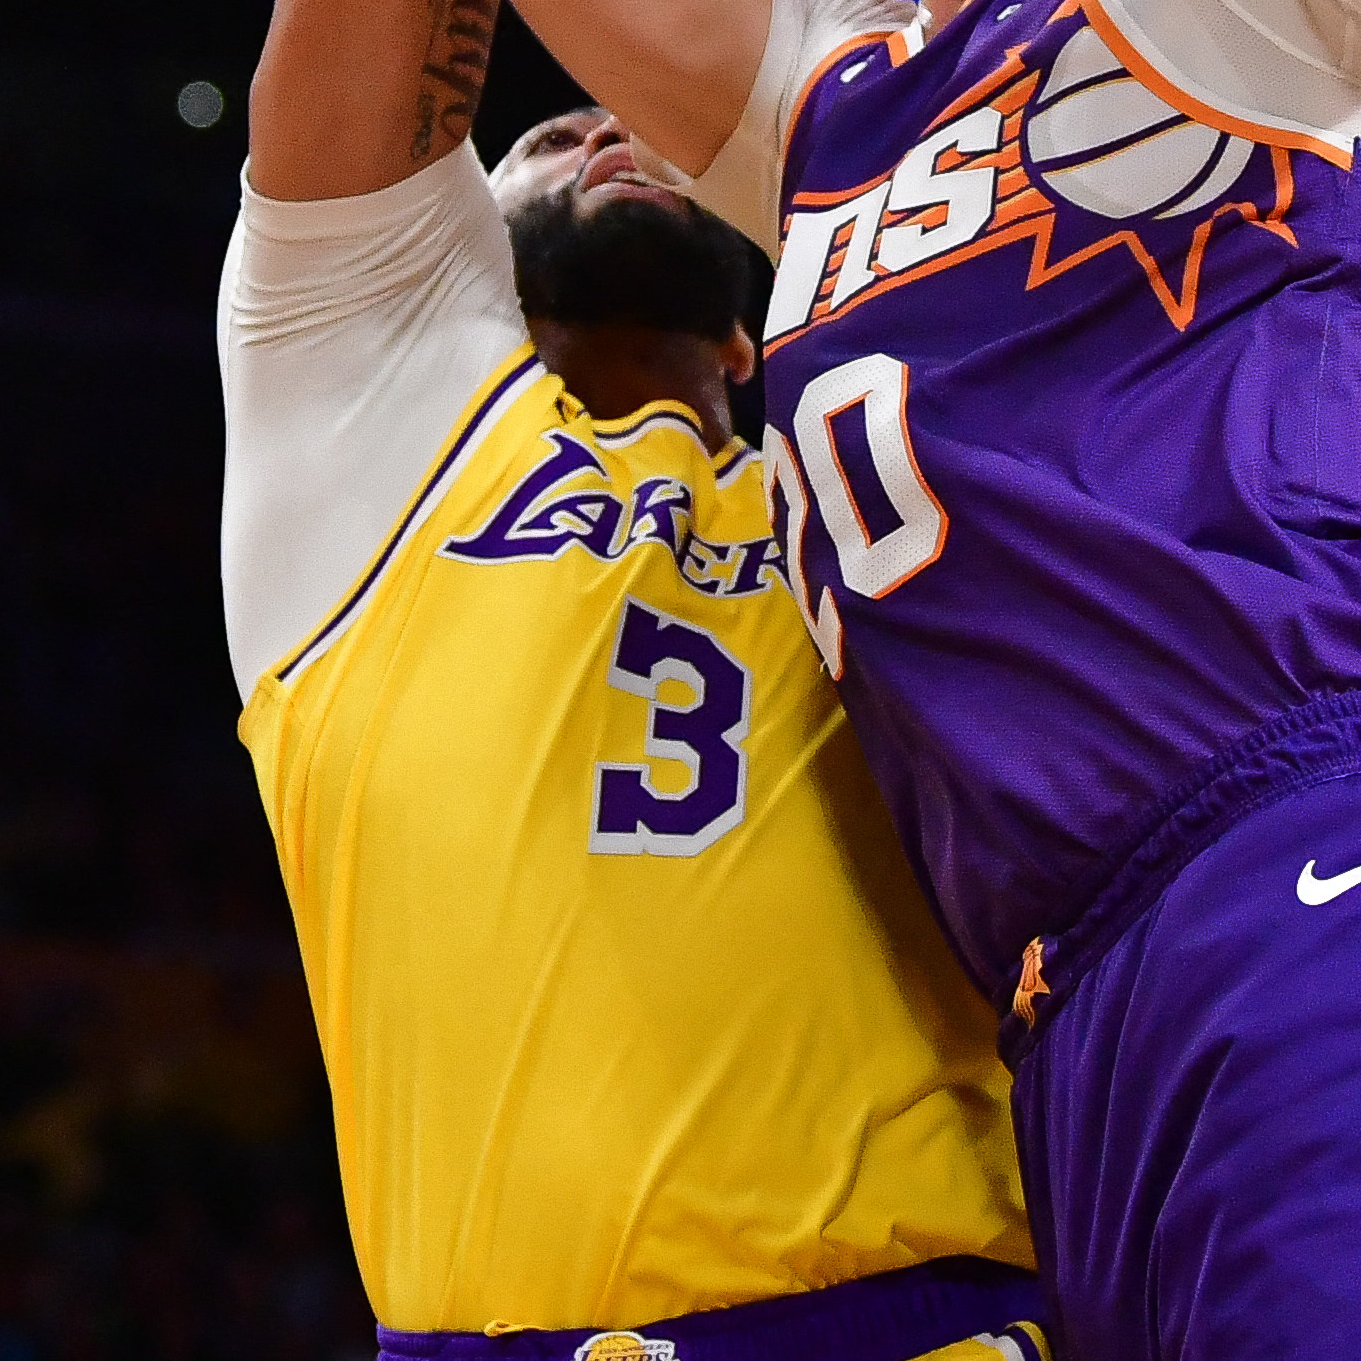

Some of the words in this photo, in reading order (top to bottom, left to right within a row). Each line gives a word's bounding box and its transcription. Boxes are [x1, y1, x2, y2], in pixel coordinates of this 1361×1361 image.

[762, 106, 1003, 343] ns
[436, 429, 791, 597] LAKER
[587, 594, 751, 858] 3
